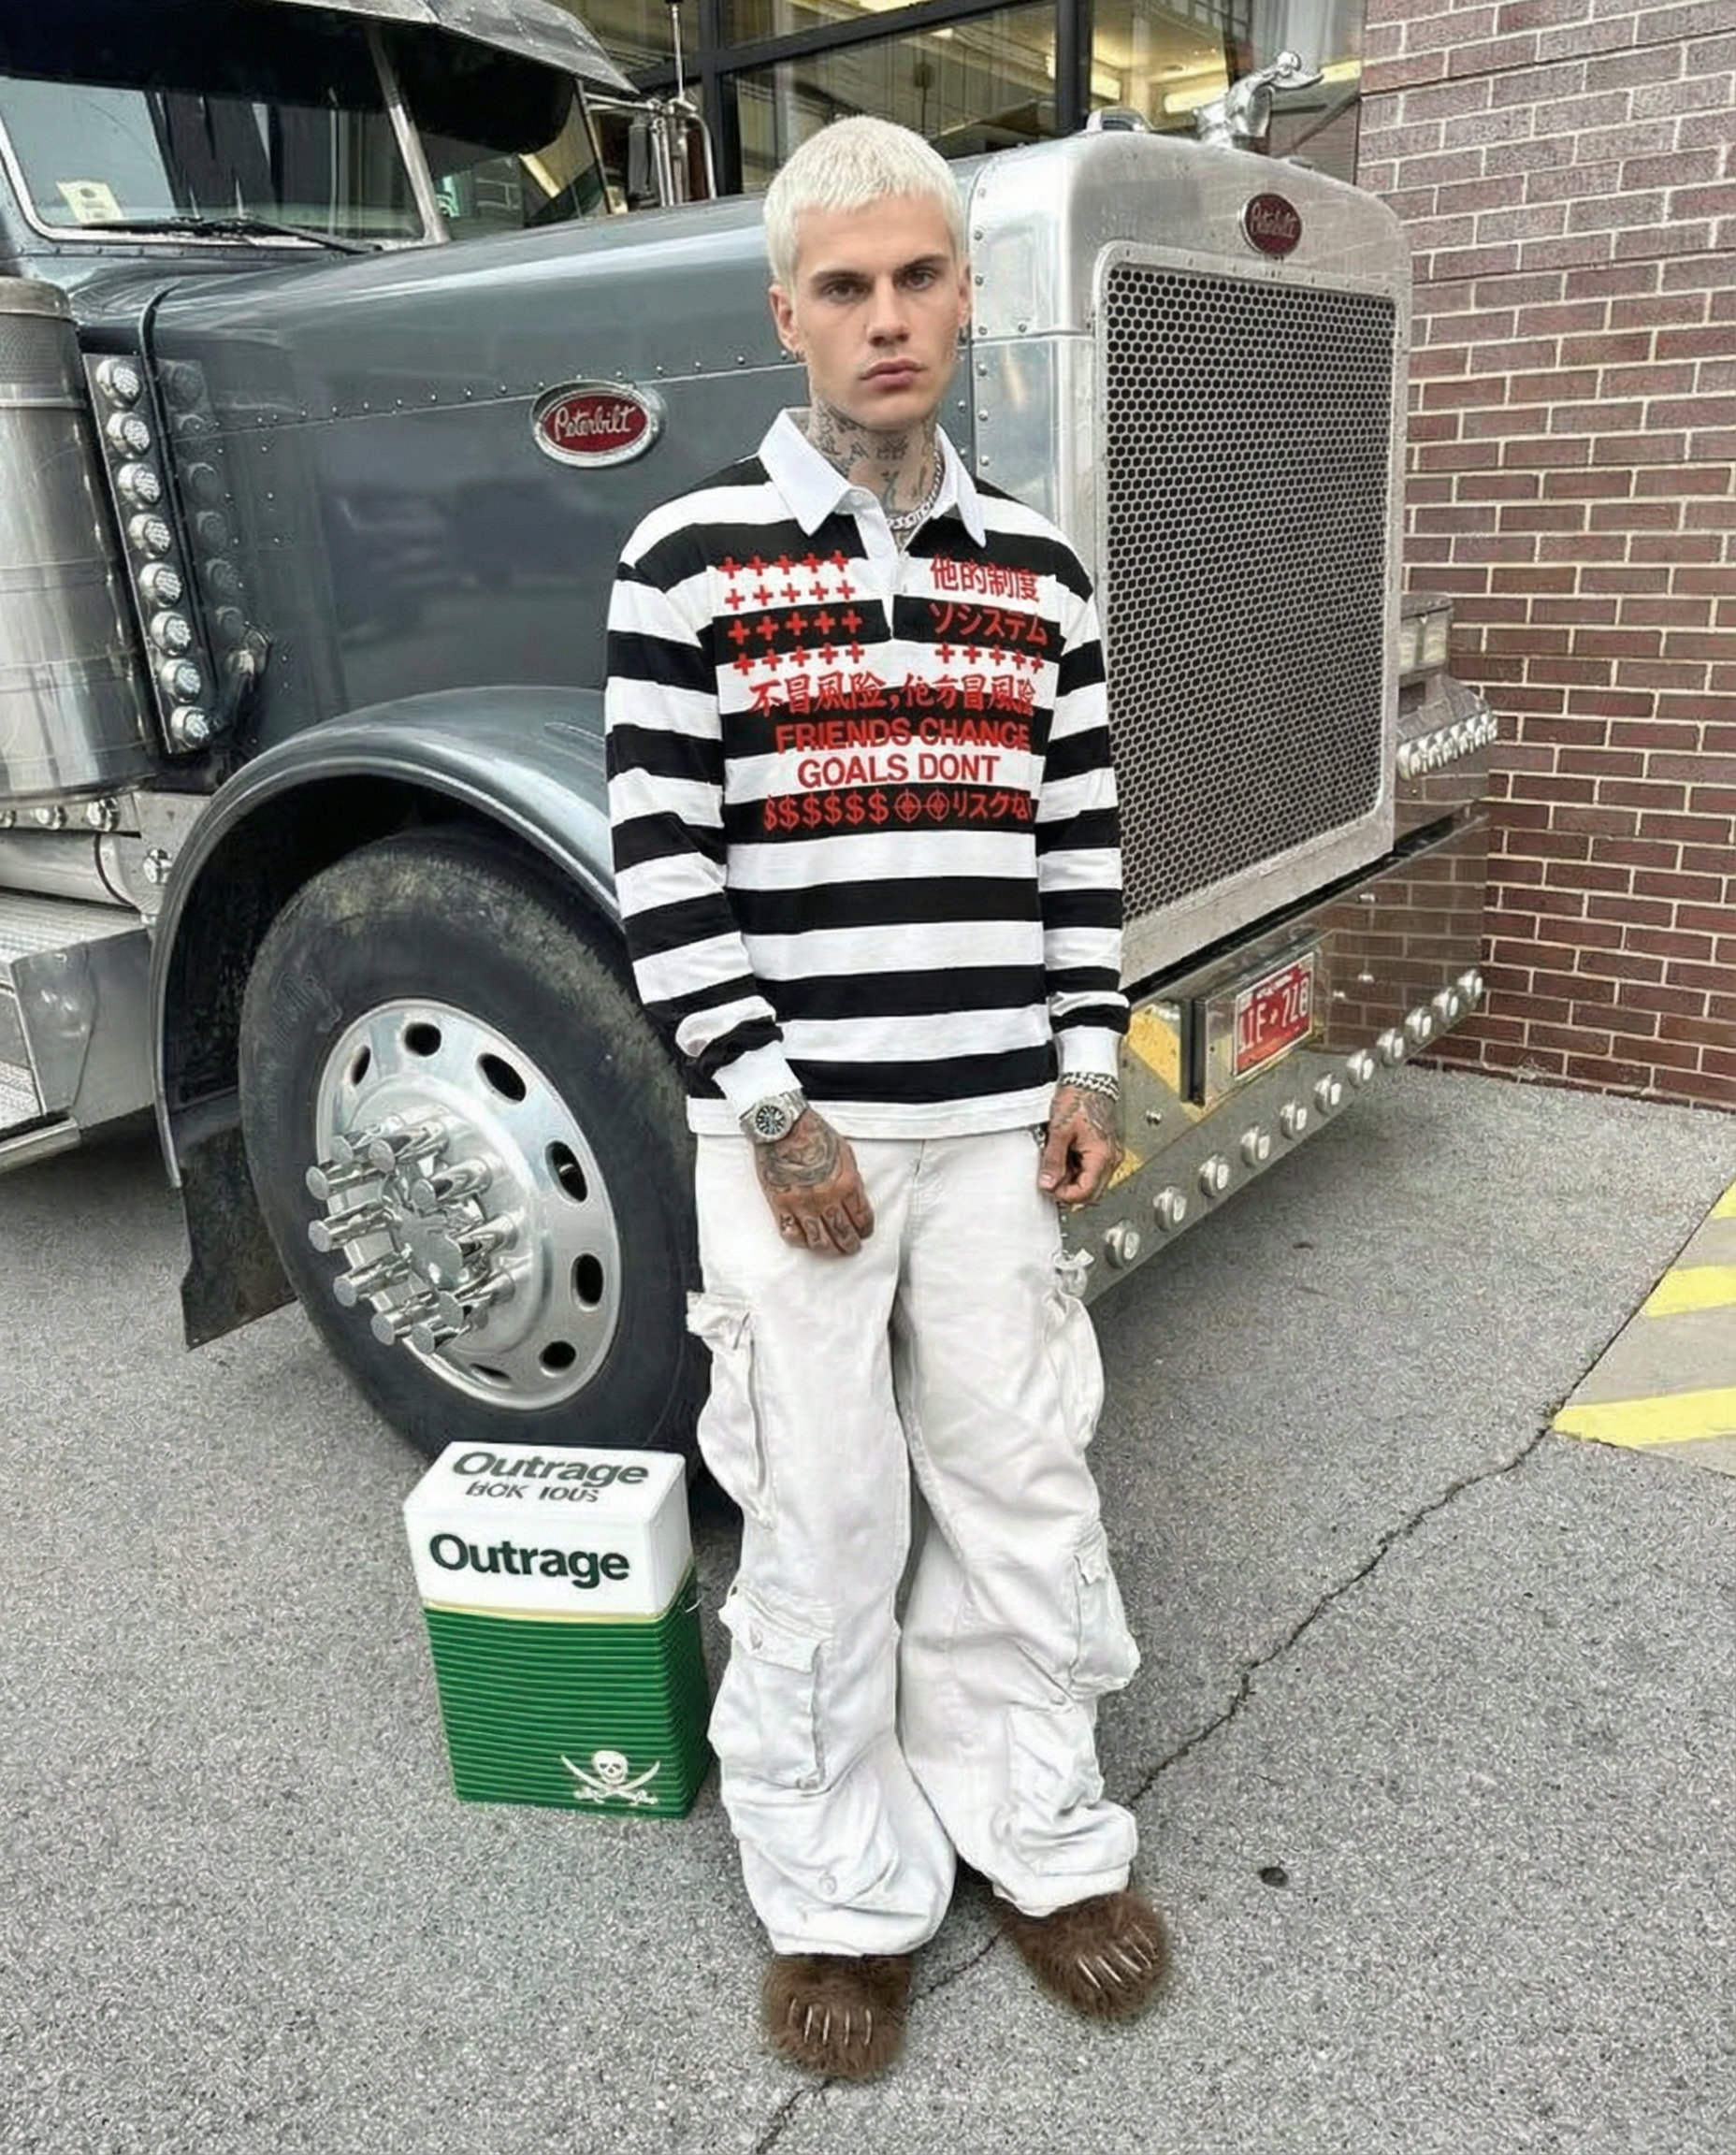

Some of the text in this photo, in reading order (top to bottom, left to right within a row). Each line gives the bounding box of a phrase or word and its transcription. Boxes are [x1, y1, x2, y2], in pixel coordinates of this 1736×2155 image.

[554, 404, 636, 441] Peterbilt
[930, 554, 1040, 602] 他的制度
[775, 717, 1031, 754] FRIENDS CHANGE
[797, 752, 1001, 788] GOALS DONT
[453, 1451, 649, 1487] Outrage
[429, 1533, 630, 1589] Outrage
